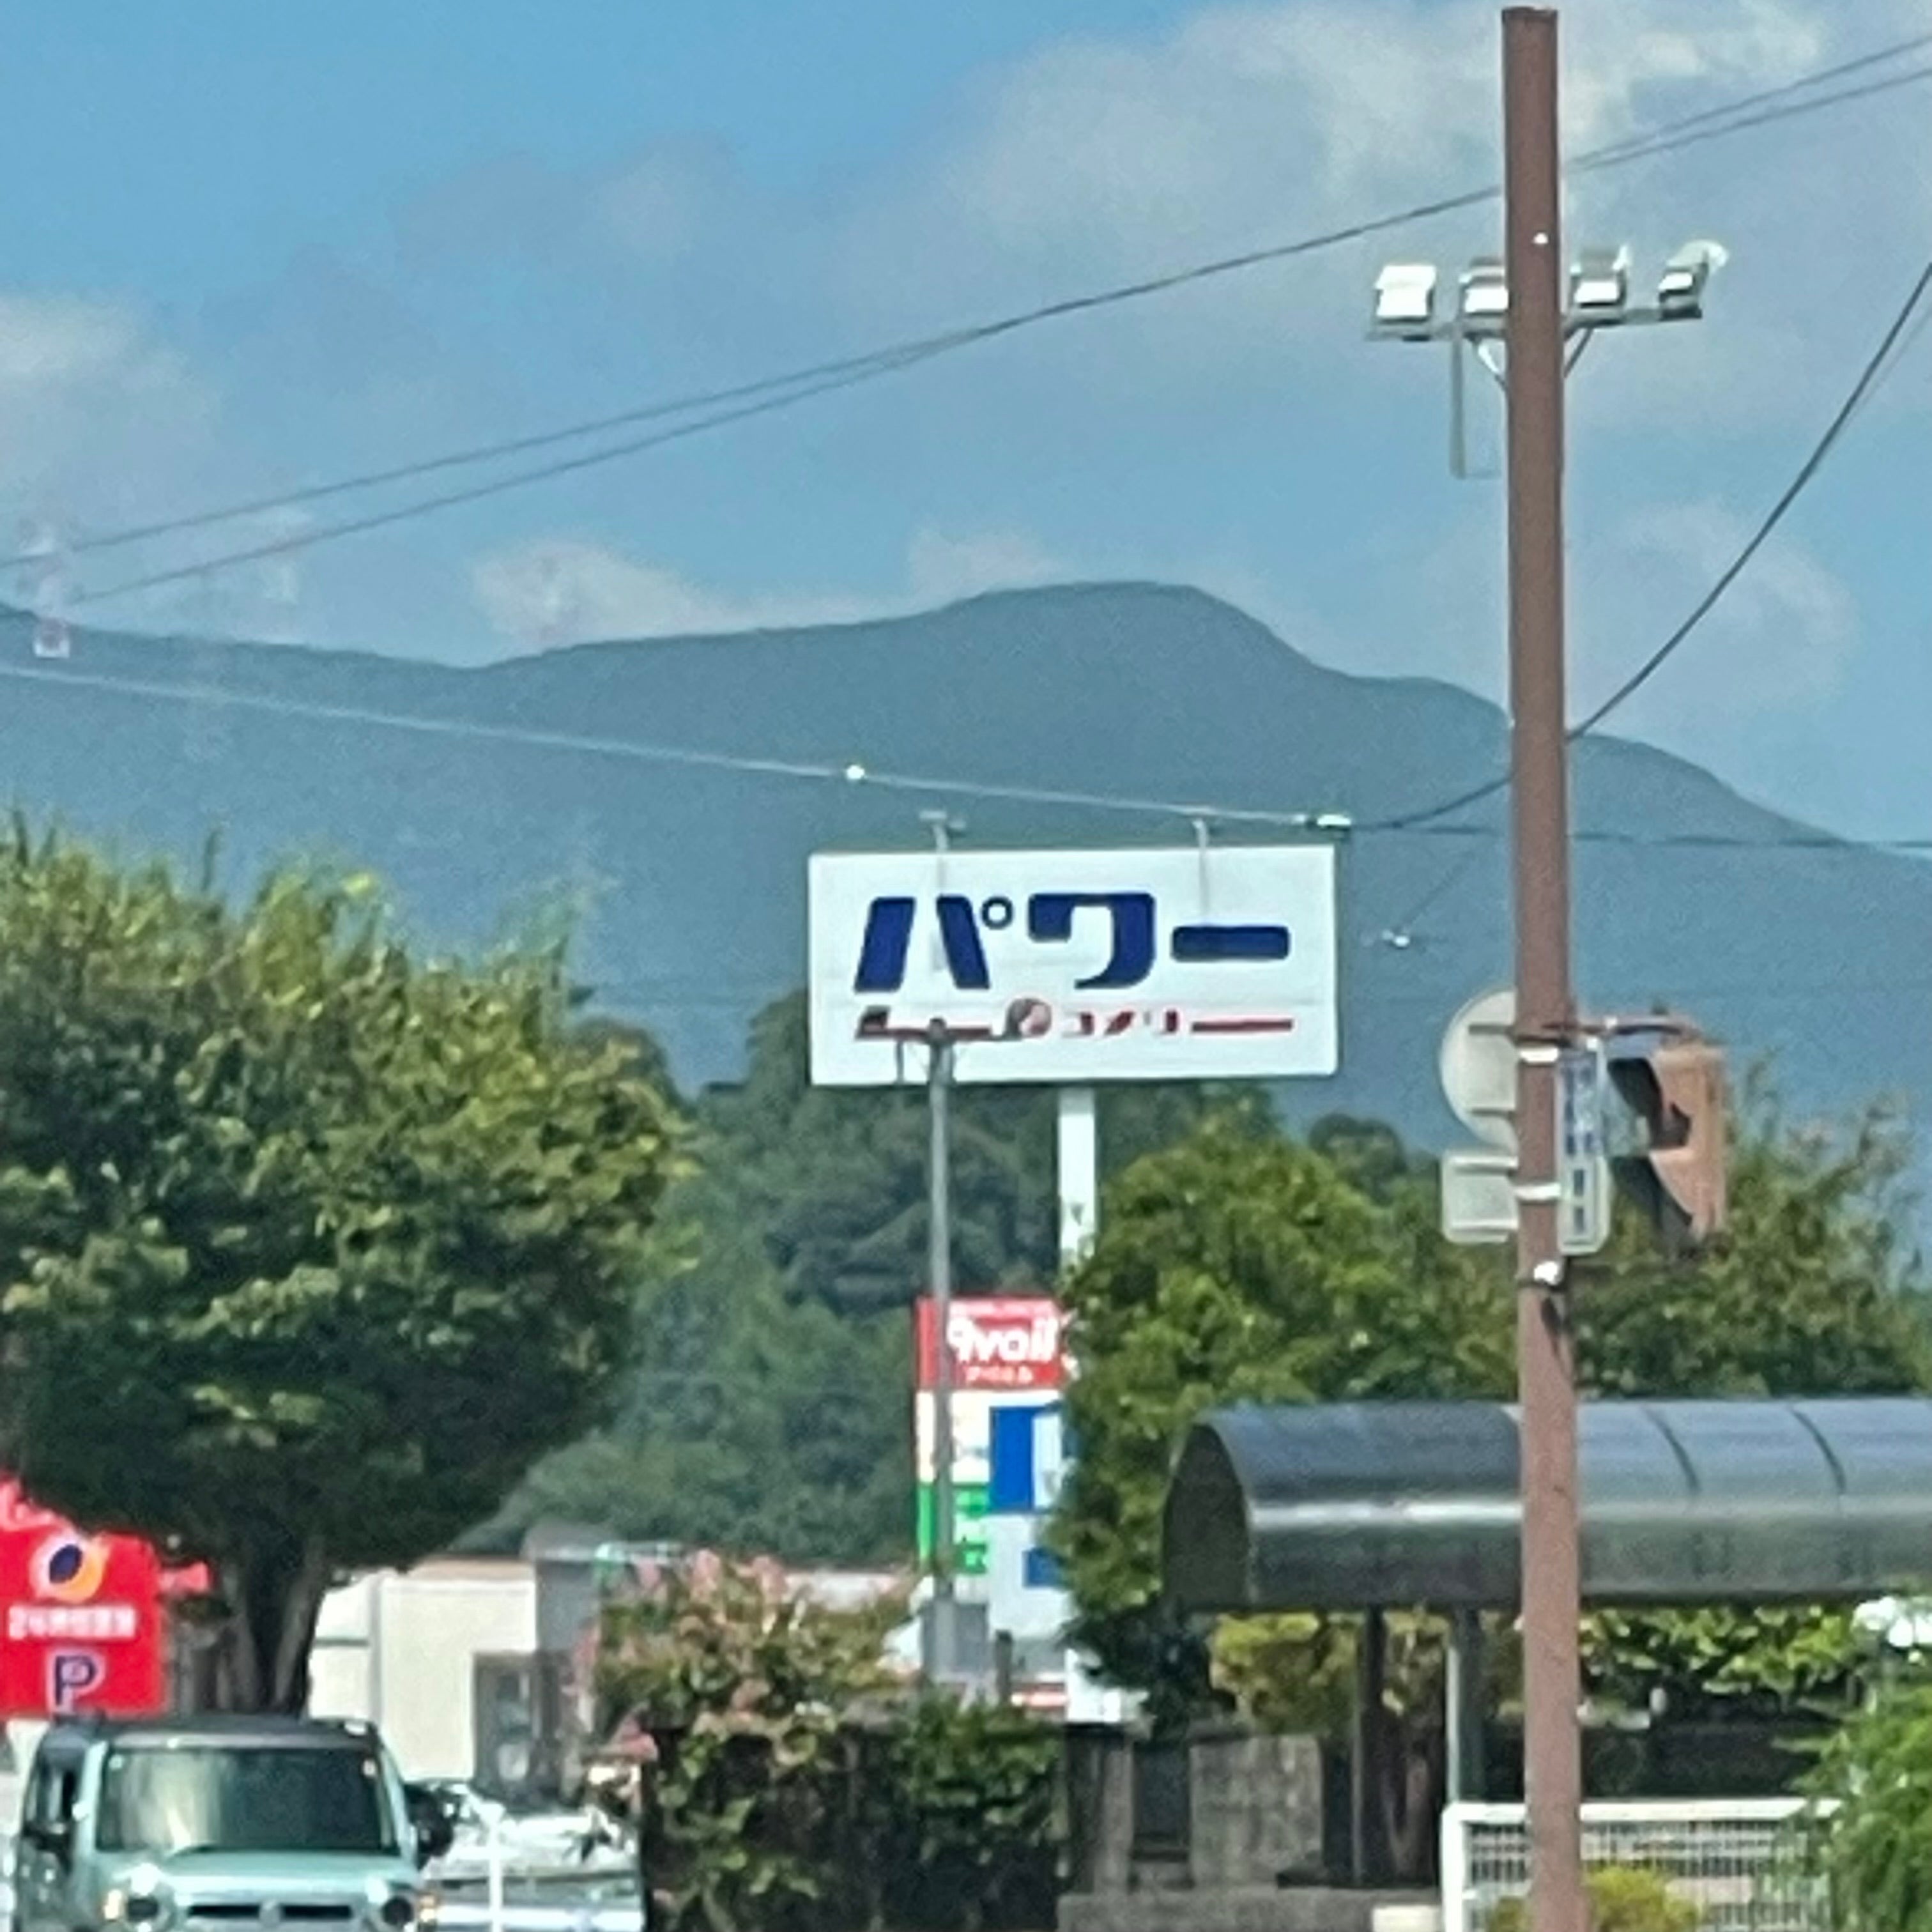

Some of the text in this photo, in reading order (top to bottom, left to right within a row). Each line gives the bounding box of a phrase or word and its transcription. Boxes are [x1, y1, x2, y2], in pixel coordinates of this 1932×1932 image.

[854, 892, 1290, 992] パワー
[50, 1651, 102, 1710] P
